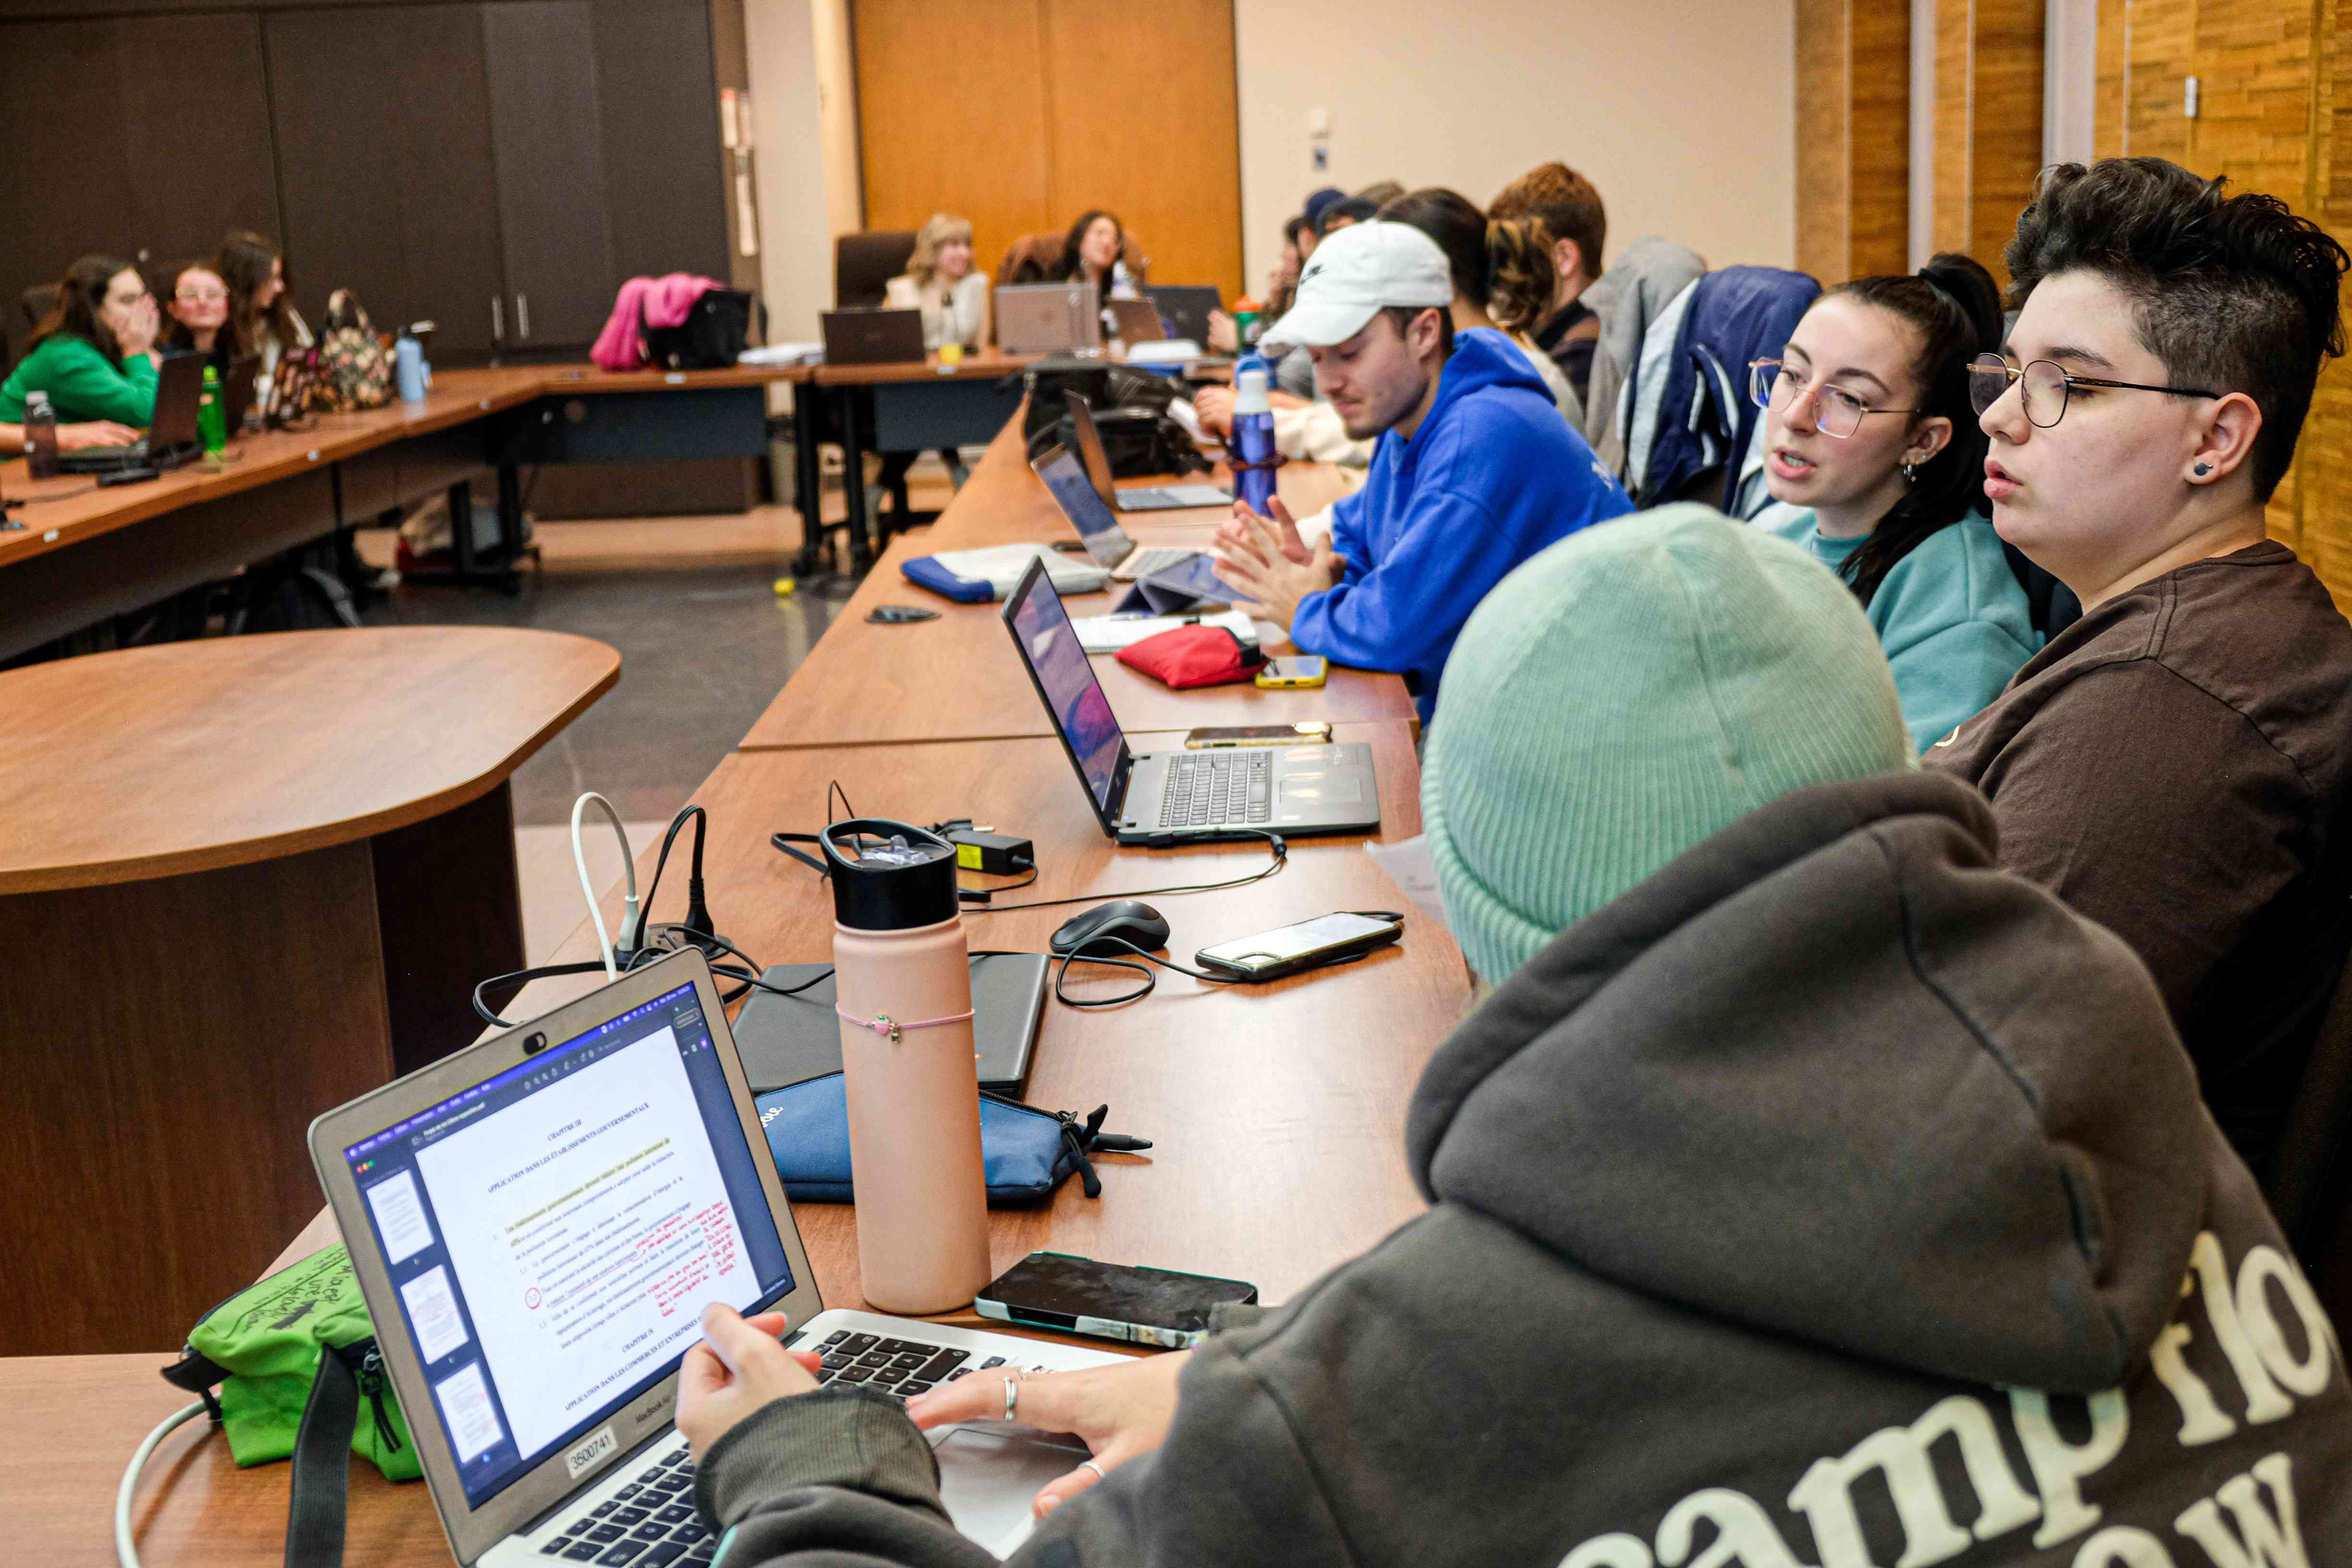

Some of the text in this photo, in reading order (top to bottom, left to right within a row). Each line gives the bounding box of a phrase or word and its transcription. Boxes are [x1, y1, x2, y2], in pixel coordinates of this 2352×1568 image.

[546, 1122, 575, 1142] CHAPITRE
[621, 1331, 648, 1353] CHAPITRE
[635, 1401, 662, 1424] MacBook
[569, 1433, 612, 1470] 3500741
